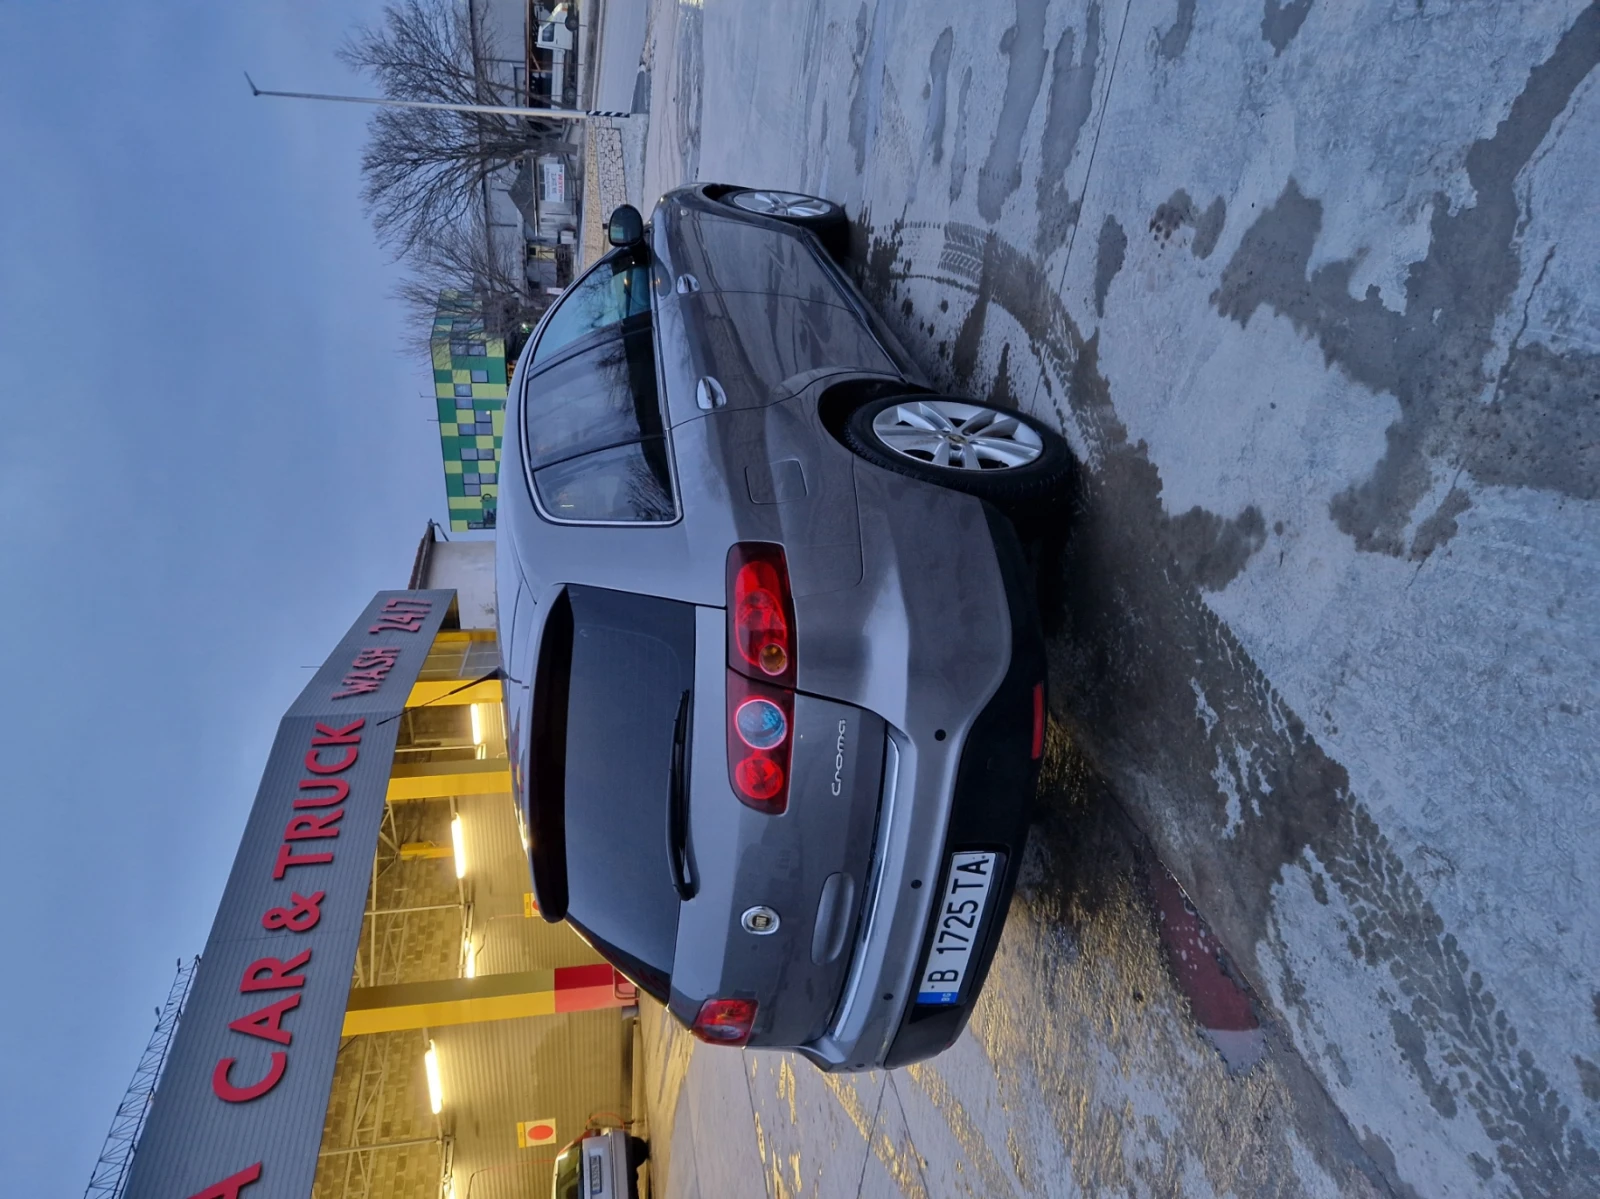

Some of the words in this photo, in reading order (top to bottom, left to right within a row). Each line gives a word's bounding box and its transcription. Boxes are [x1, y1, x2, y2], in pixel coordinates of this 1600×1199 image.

[331, 647, 401, 699] WASH
[368, 598, 432, 634] 24/7
[831, 718, 846, 796] Croma
[272, 717, 366, 880] TRUCK
[261, 891, 325, 931] &
[936, 900, 980, 954] 1725
[928, 970, 959, 982] B
[211, 948, 312, 1102] CAR
